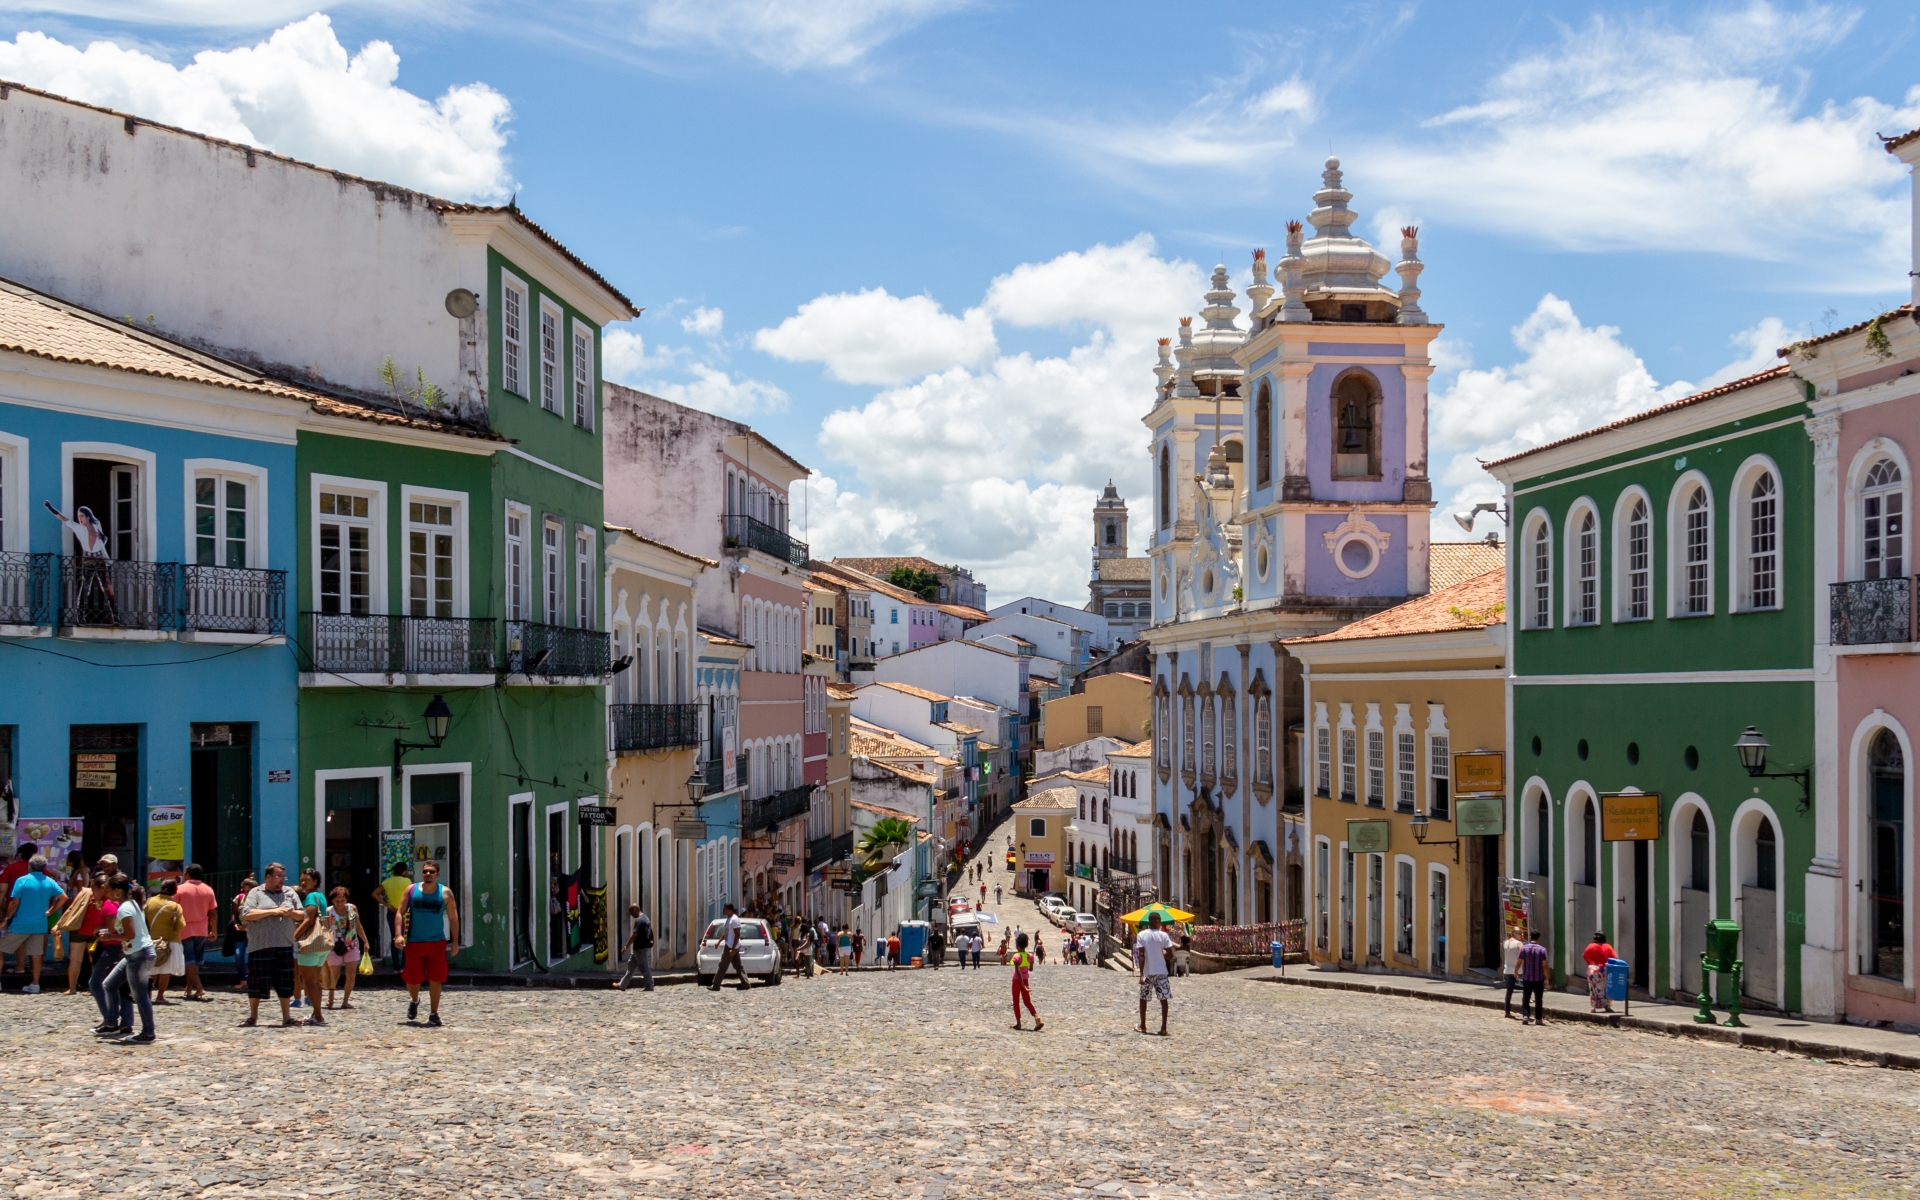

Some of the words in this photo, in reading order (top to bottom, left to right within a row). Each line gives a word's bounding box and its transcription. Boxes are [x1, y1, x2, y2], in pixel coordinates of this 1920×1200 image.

[1464, 764, 1494, 776] Teatro
[1604, 804, 1657, 816] Restaurante
[151, 812, 169, 821] Café
[170, 812, 183, 820] Bar
